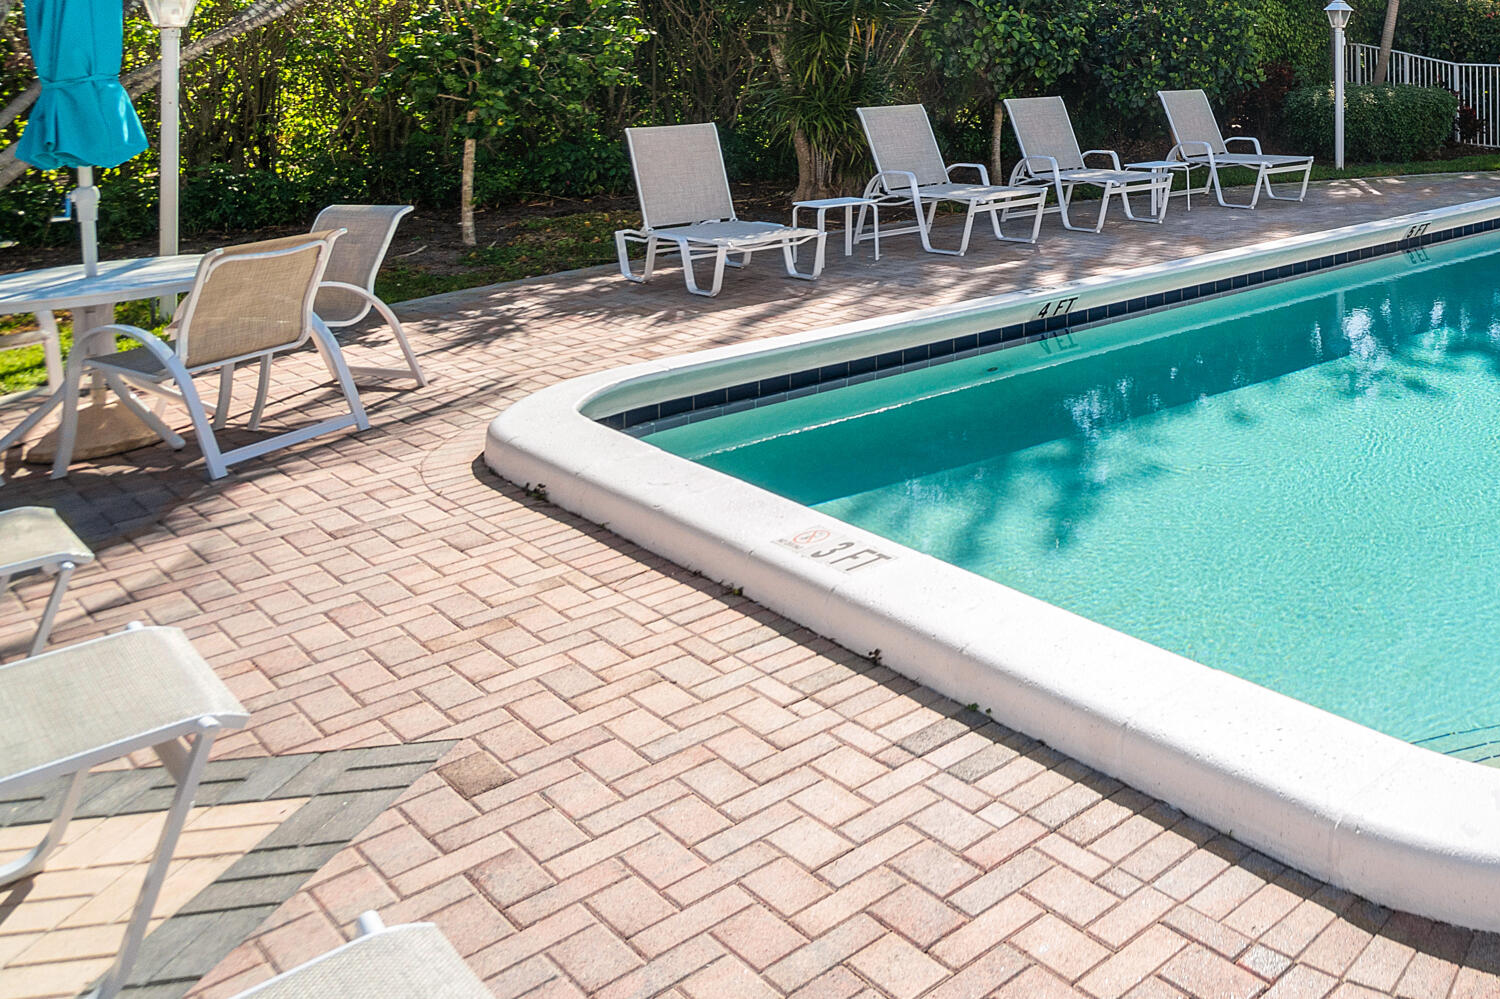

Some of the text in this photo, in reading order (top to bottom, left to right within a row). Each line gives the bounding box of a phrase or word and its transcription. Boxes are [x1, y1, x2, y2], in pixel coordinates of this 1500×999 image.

[1407, 222, 1431, 238] 5 FT
[1038, 297, 1079, 319] 4 FT
[811, 542, 855, 559] 3
[829, 549, 891, 572] FT
